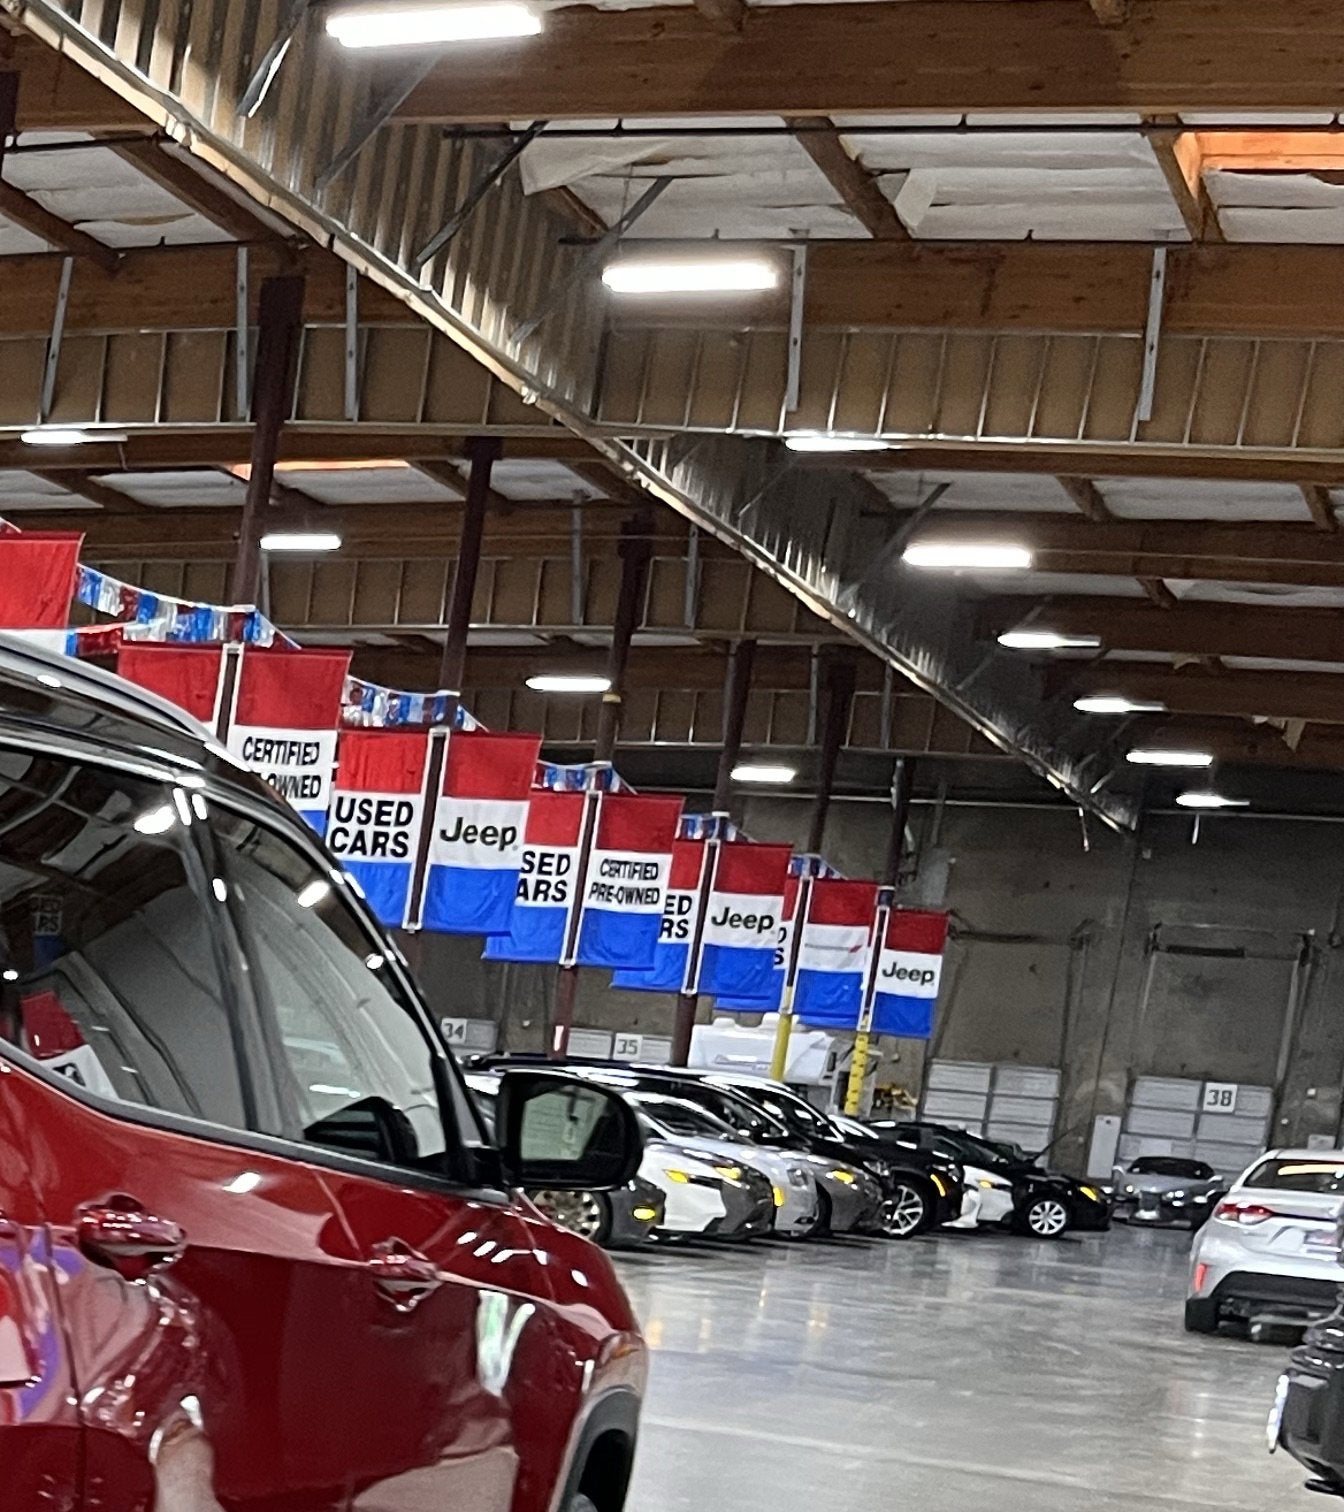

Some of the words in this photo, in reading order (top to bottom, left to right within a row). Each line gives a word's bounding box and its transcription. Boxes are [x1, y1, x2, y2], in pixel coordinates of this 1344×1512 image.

[242, 736, 320, 766] CERTIFIED
[335, 796, 414, 828] USED
[330, 826, 409, 858] CARS
[439, 816, 518, 852] Jeep
[520, 850, 571, 876] SED
[599, 858, 659, 881] CERTIFIED
[516, 877, 568, 902] ARS
[588, 881, 661, 905] PRE-OWNED
[664, 894, 693, 916] ED
[659, 918, 689, 939] RS
[710, 906, 775, 934] Jeep
[881, 961, 936, 986] Jeep
[444, 1022, 465, 1040] 34
[618, 1038, 639, 1056] 35
[1206, 1089, 1233, 1107] 38
